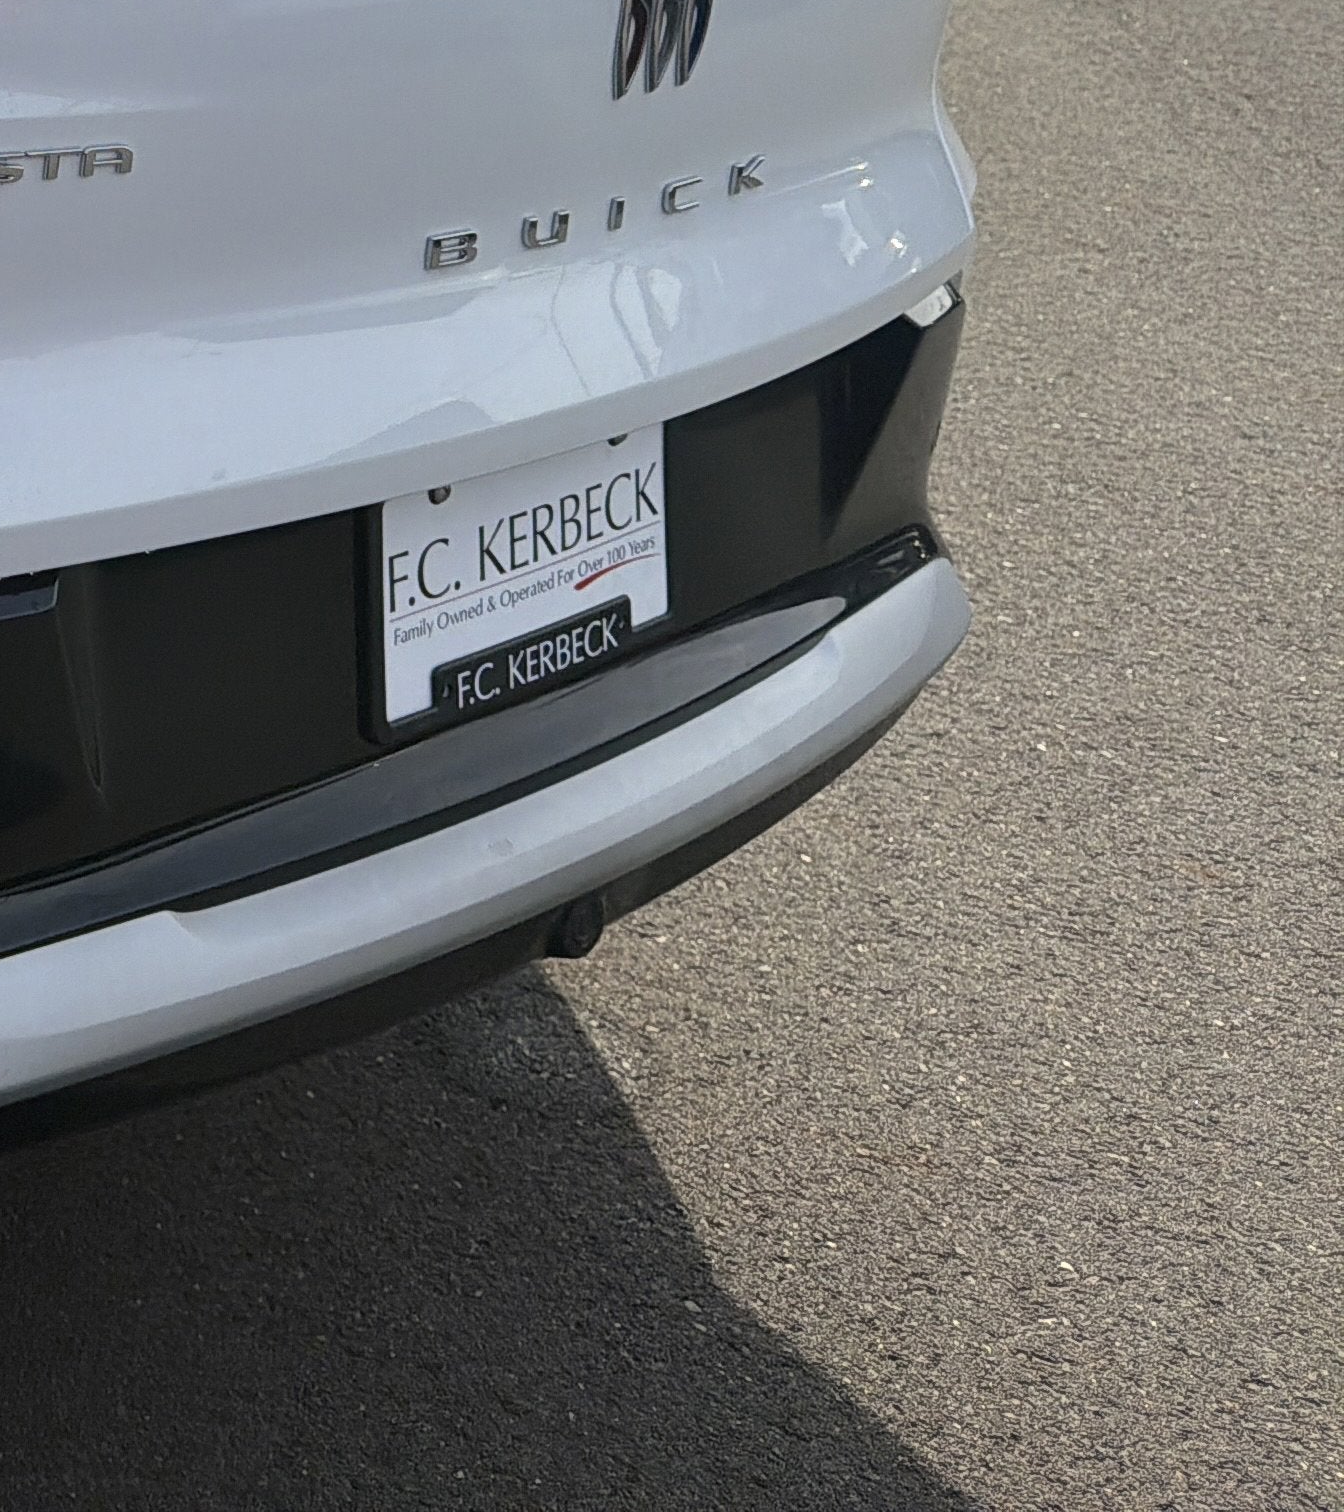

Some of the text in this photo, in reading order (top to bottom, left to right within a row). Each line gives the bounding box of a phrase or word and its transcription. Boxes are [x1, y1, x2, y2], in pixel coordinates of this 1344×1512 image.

[423, 153, 765, 272] BUICK
[388, 462, 660, 613] F.C. KERBECK
[393, 536, 656, 646] Family Owned & Operated For Over 100 Years
[458, 614, 619, 709] F.C. KERBECK
